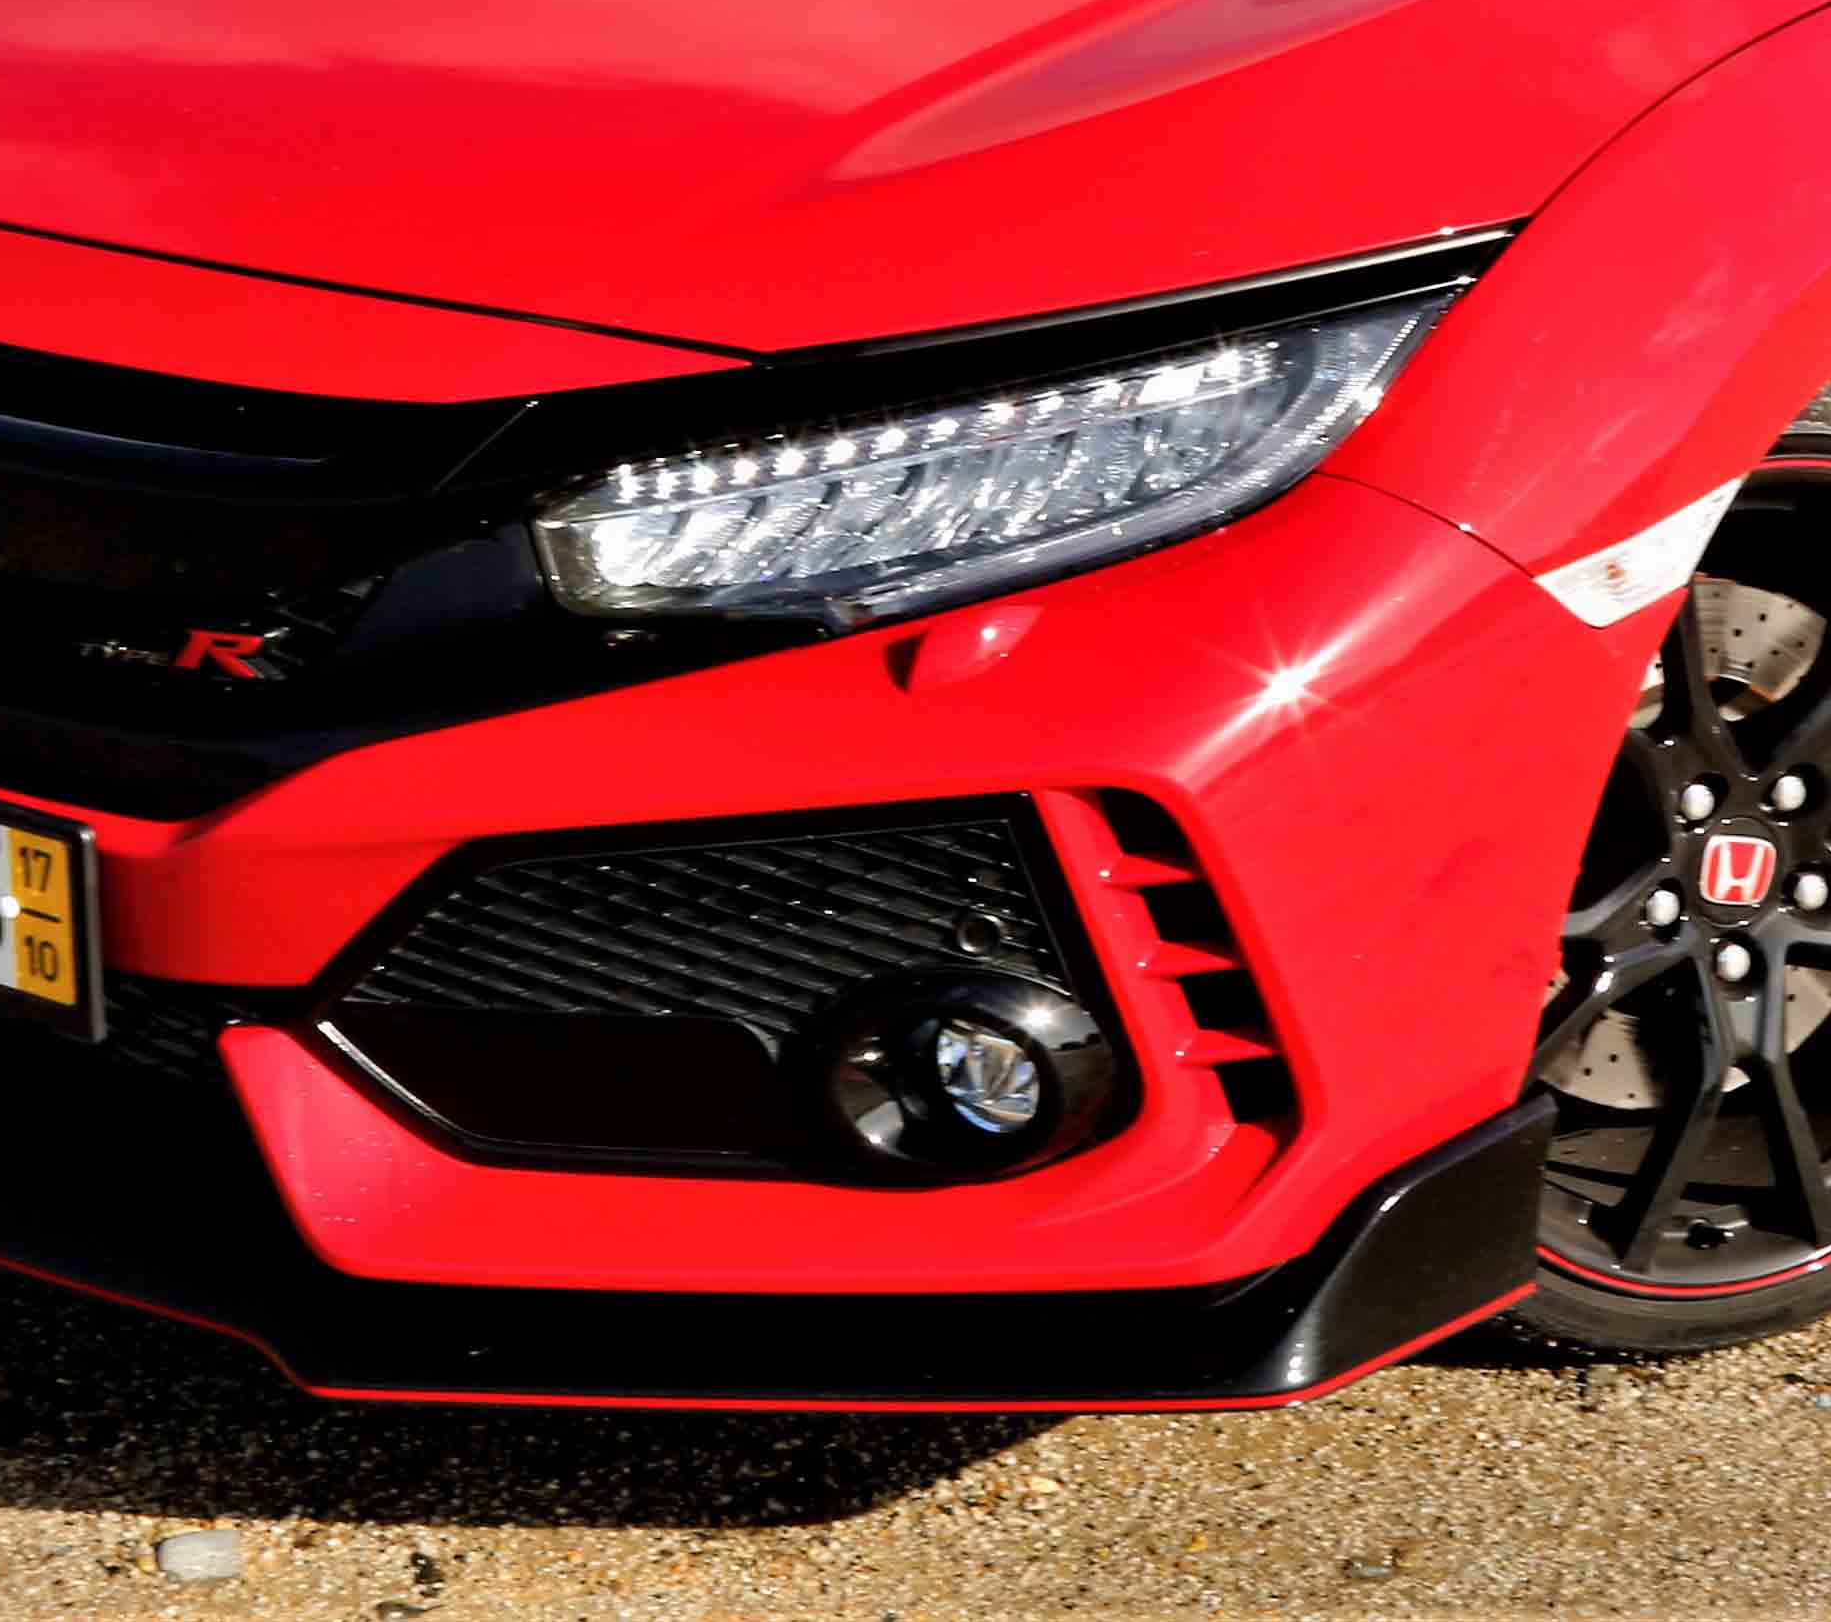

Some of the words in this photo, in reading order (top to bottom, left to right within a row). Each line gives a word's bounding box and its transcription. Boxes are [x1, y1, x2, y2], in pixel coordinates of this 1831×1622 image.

[173, 627, 266, 679] R
[17, 844, 52, 894] 17
[24, 934, 60, 983] 10
